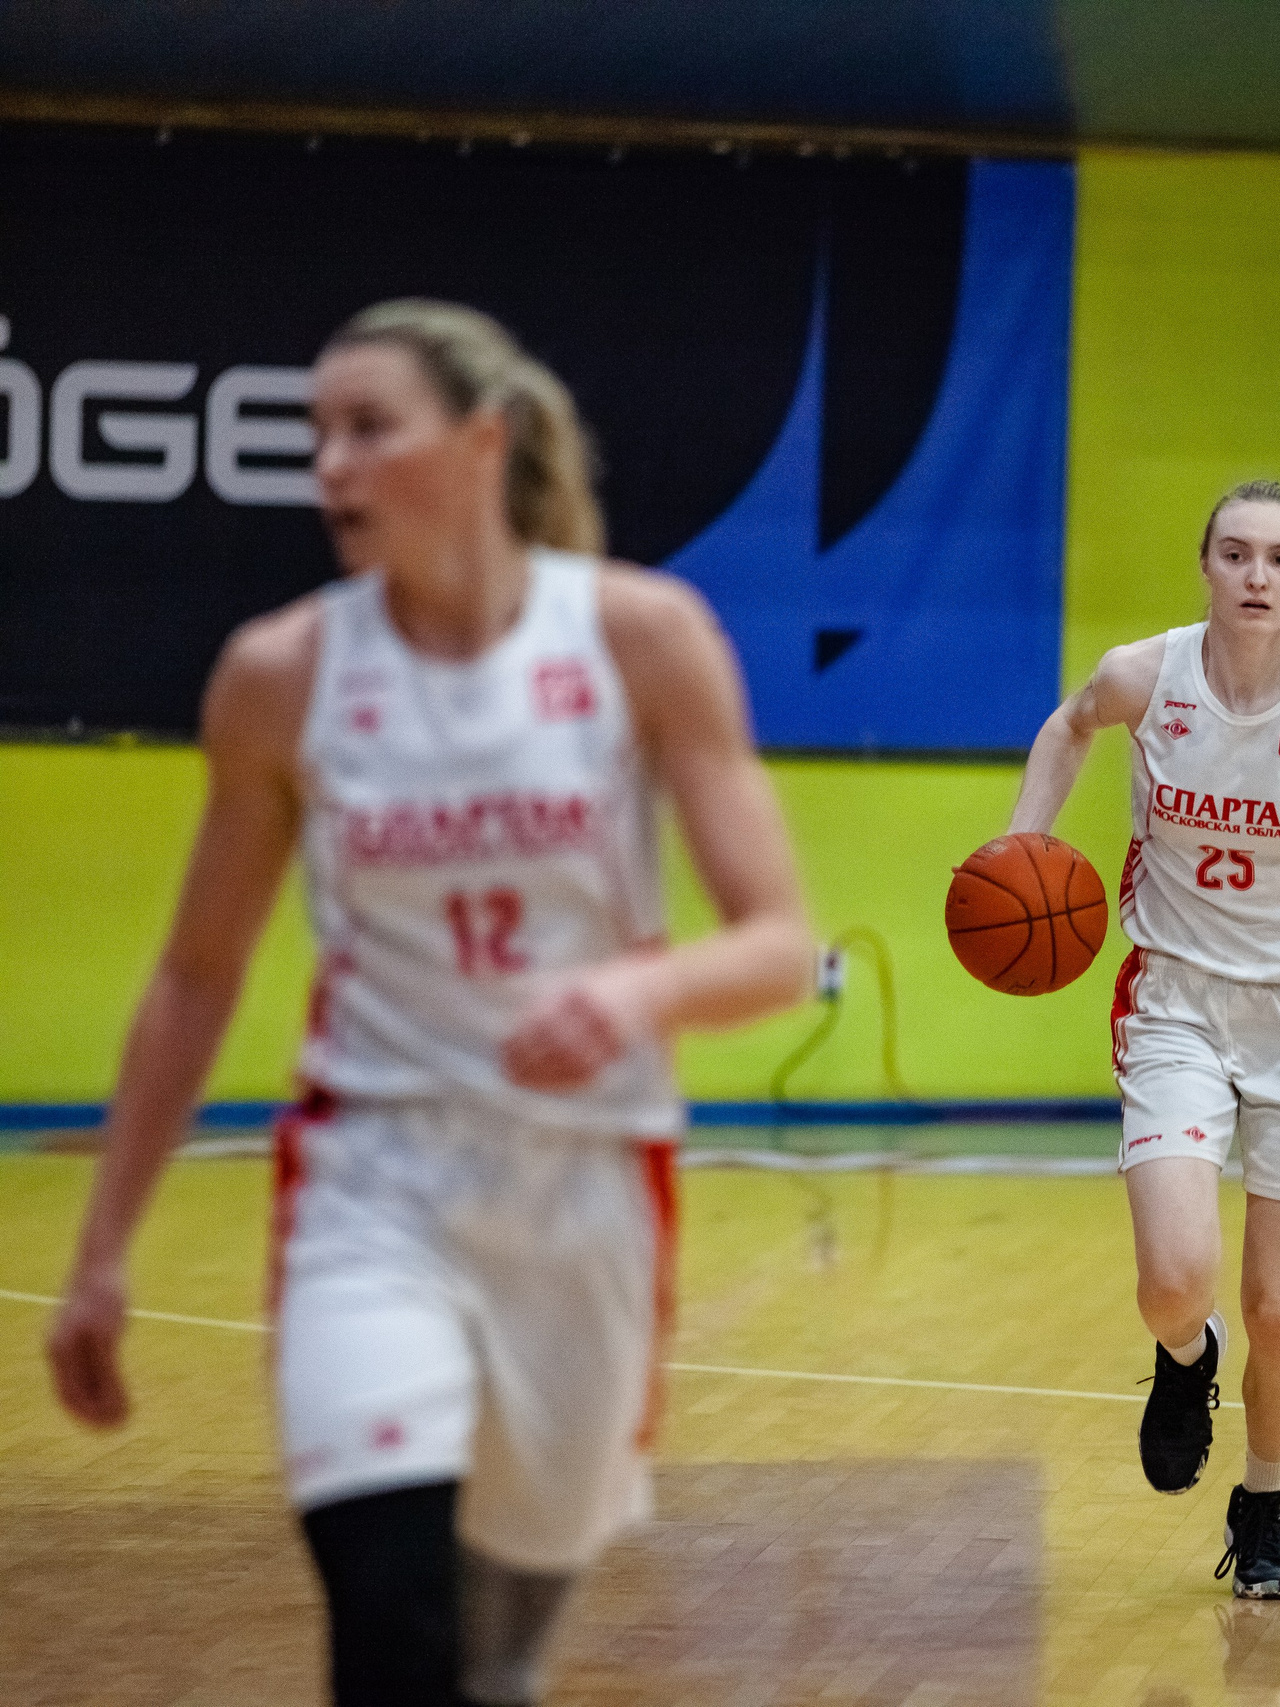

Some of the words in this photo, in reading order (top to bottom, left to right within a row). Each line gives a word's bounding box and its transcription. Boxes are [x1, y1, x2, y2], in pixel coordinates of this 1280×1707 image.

[1152, 806, 1241, 834] МОСКОВСКАЯ
[1196, 844, 1256, 892] 25
[444, 886, 528, 977] 12
